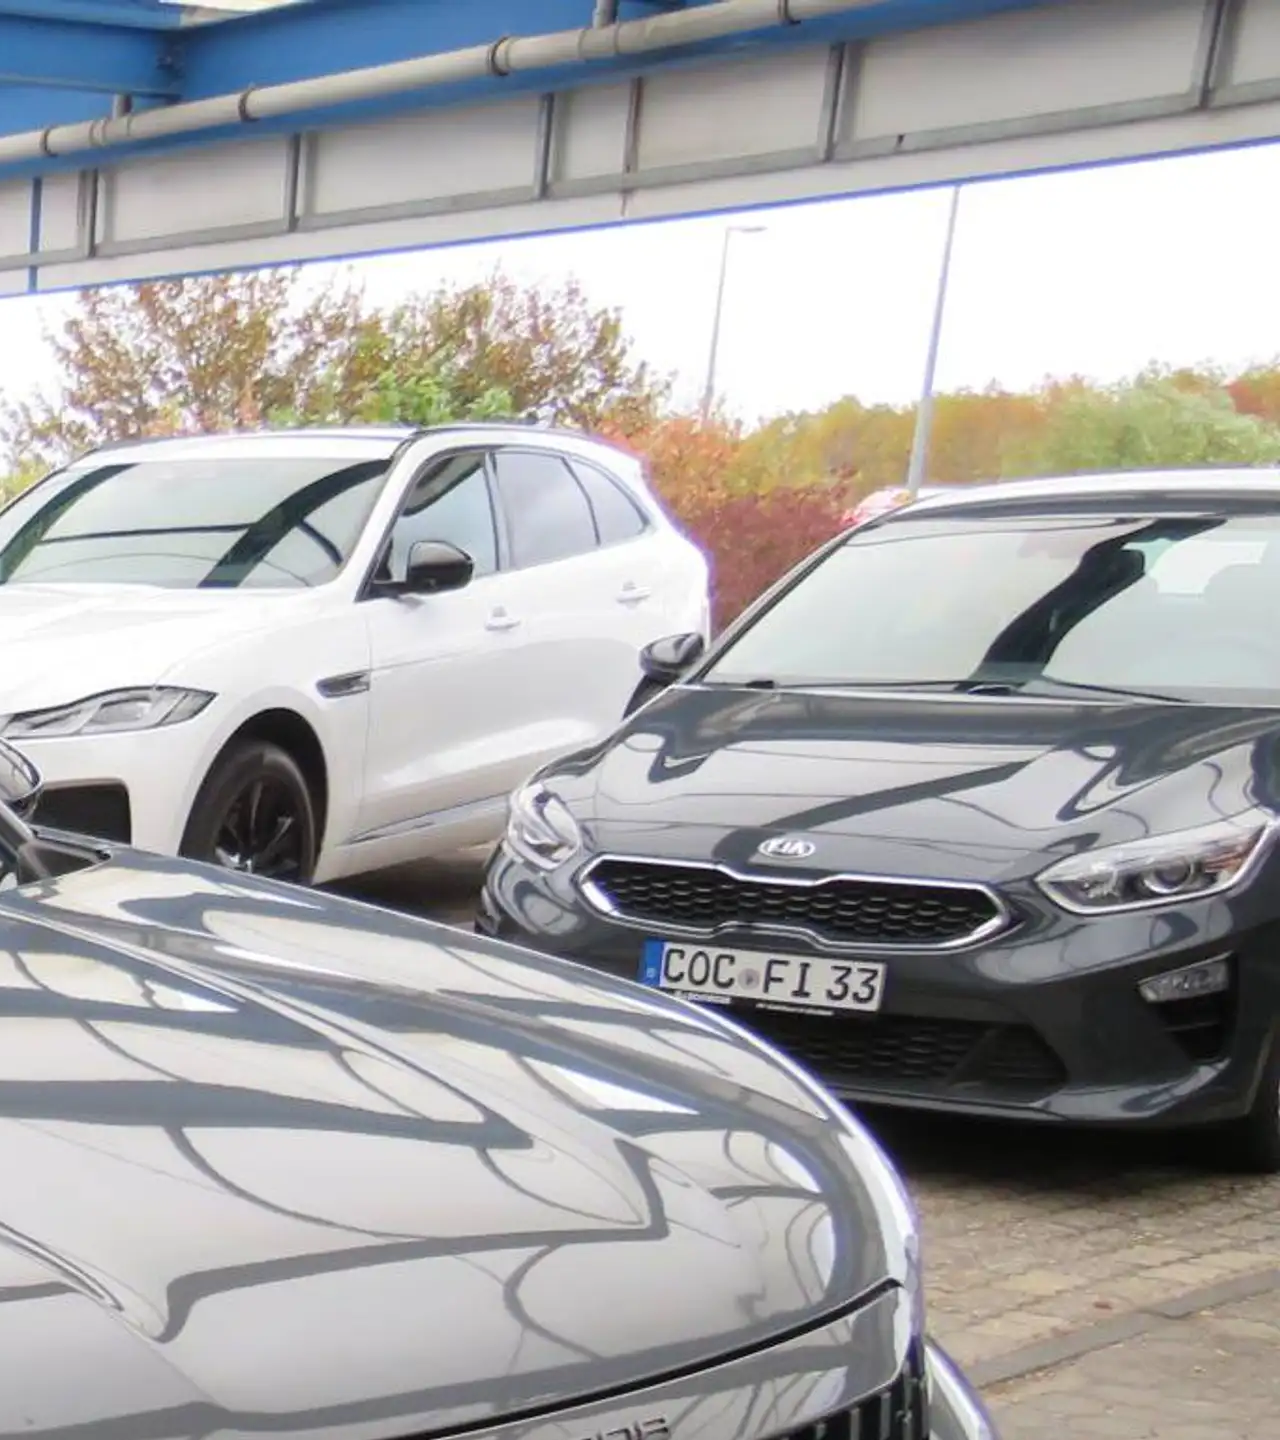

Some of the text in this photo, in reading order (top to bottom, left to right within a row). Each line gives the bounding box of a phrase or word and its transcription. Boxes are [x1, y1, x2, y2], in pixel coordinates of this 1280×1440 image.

[662, 947, 879, 1005] COC FI 33
